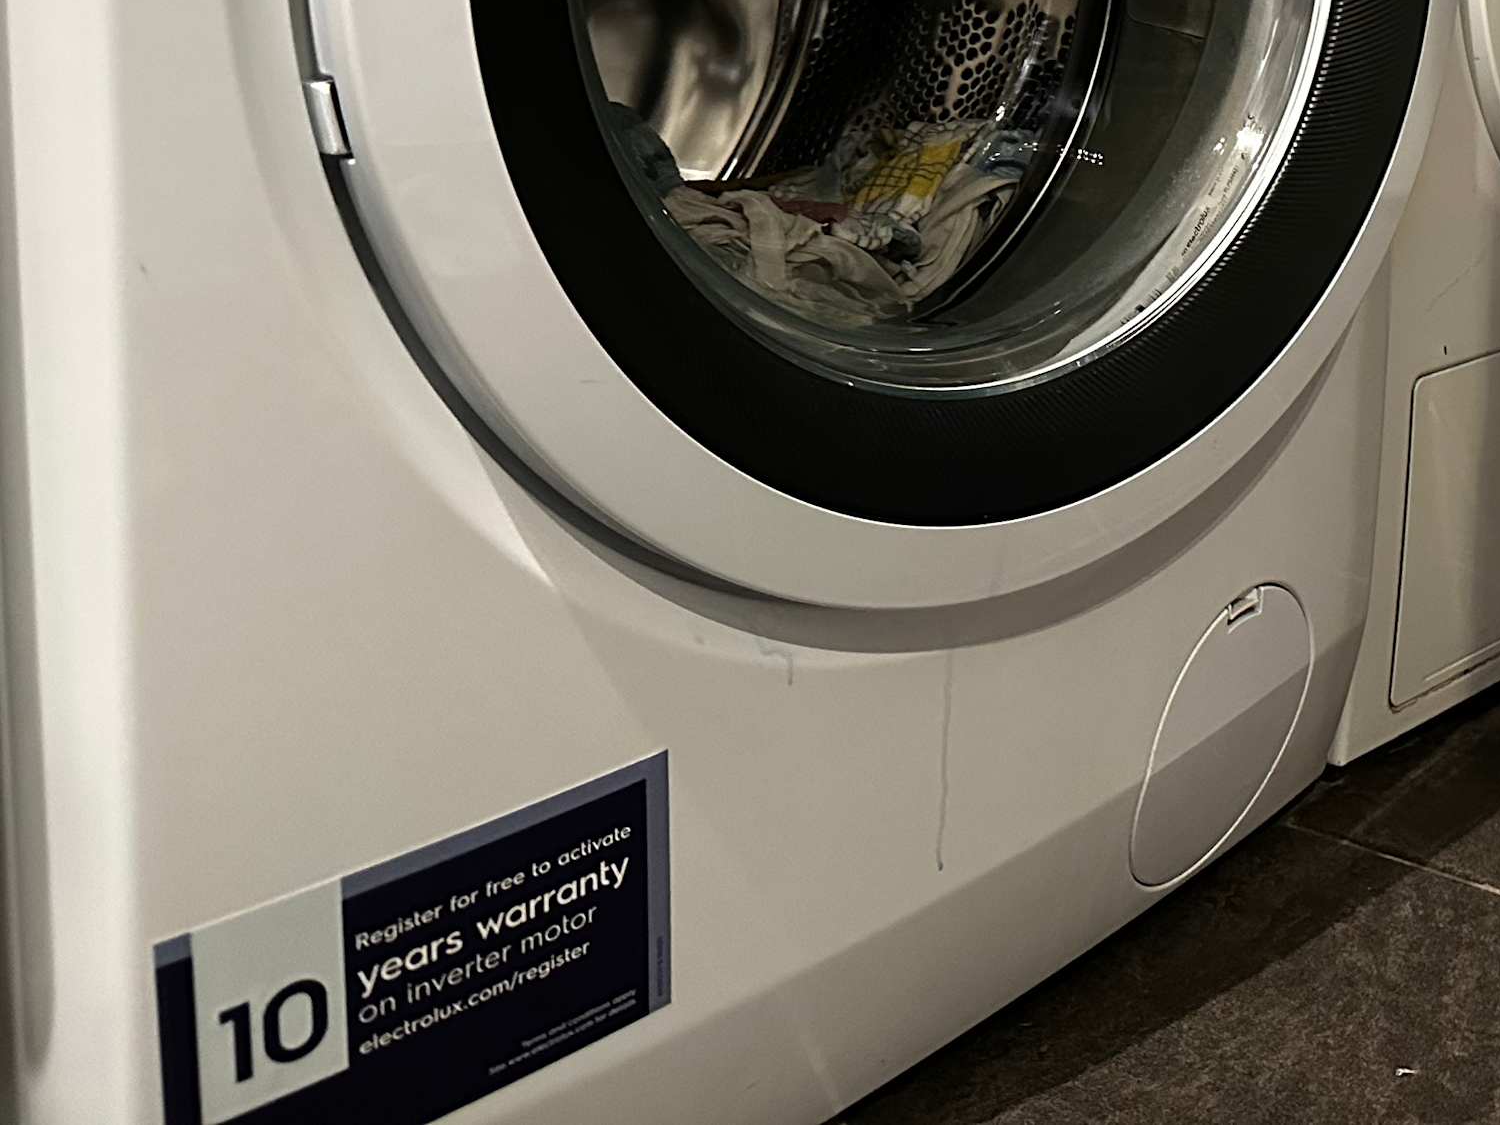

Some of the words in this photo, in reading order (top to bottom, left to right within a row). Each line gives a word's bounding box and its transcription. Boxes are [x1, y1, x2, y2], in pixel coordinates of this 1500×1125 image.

[355, 904, 443, 950] Register
[450, 890, 479, 912] for
[486, 872, 526, 897] free
[532, 861, 551, 877] to
[557, 827, 631, 866] activate
[357, 931, 463, 999] years
[476, 857, 629, 940] warranty
[358, 996, 396, 1023] on
[406, 945, 512, 1004] inverter
[521, 906, 598, 954] motor
[359, 942, 590, 1055] electrolux.com/register
[218, 978, 329, 1084] 10
